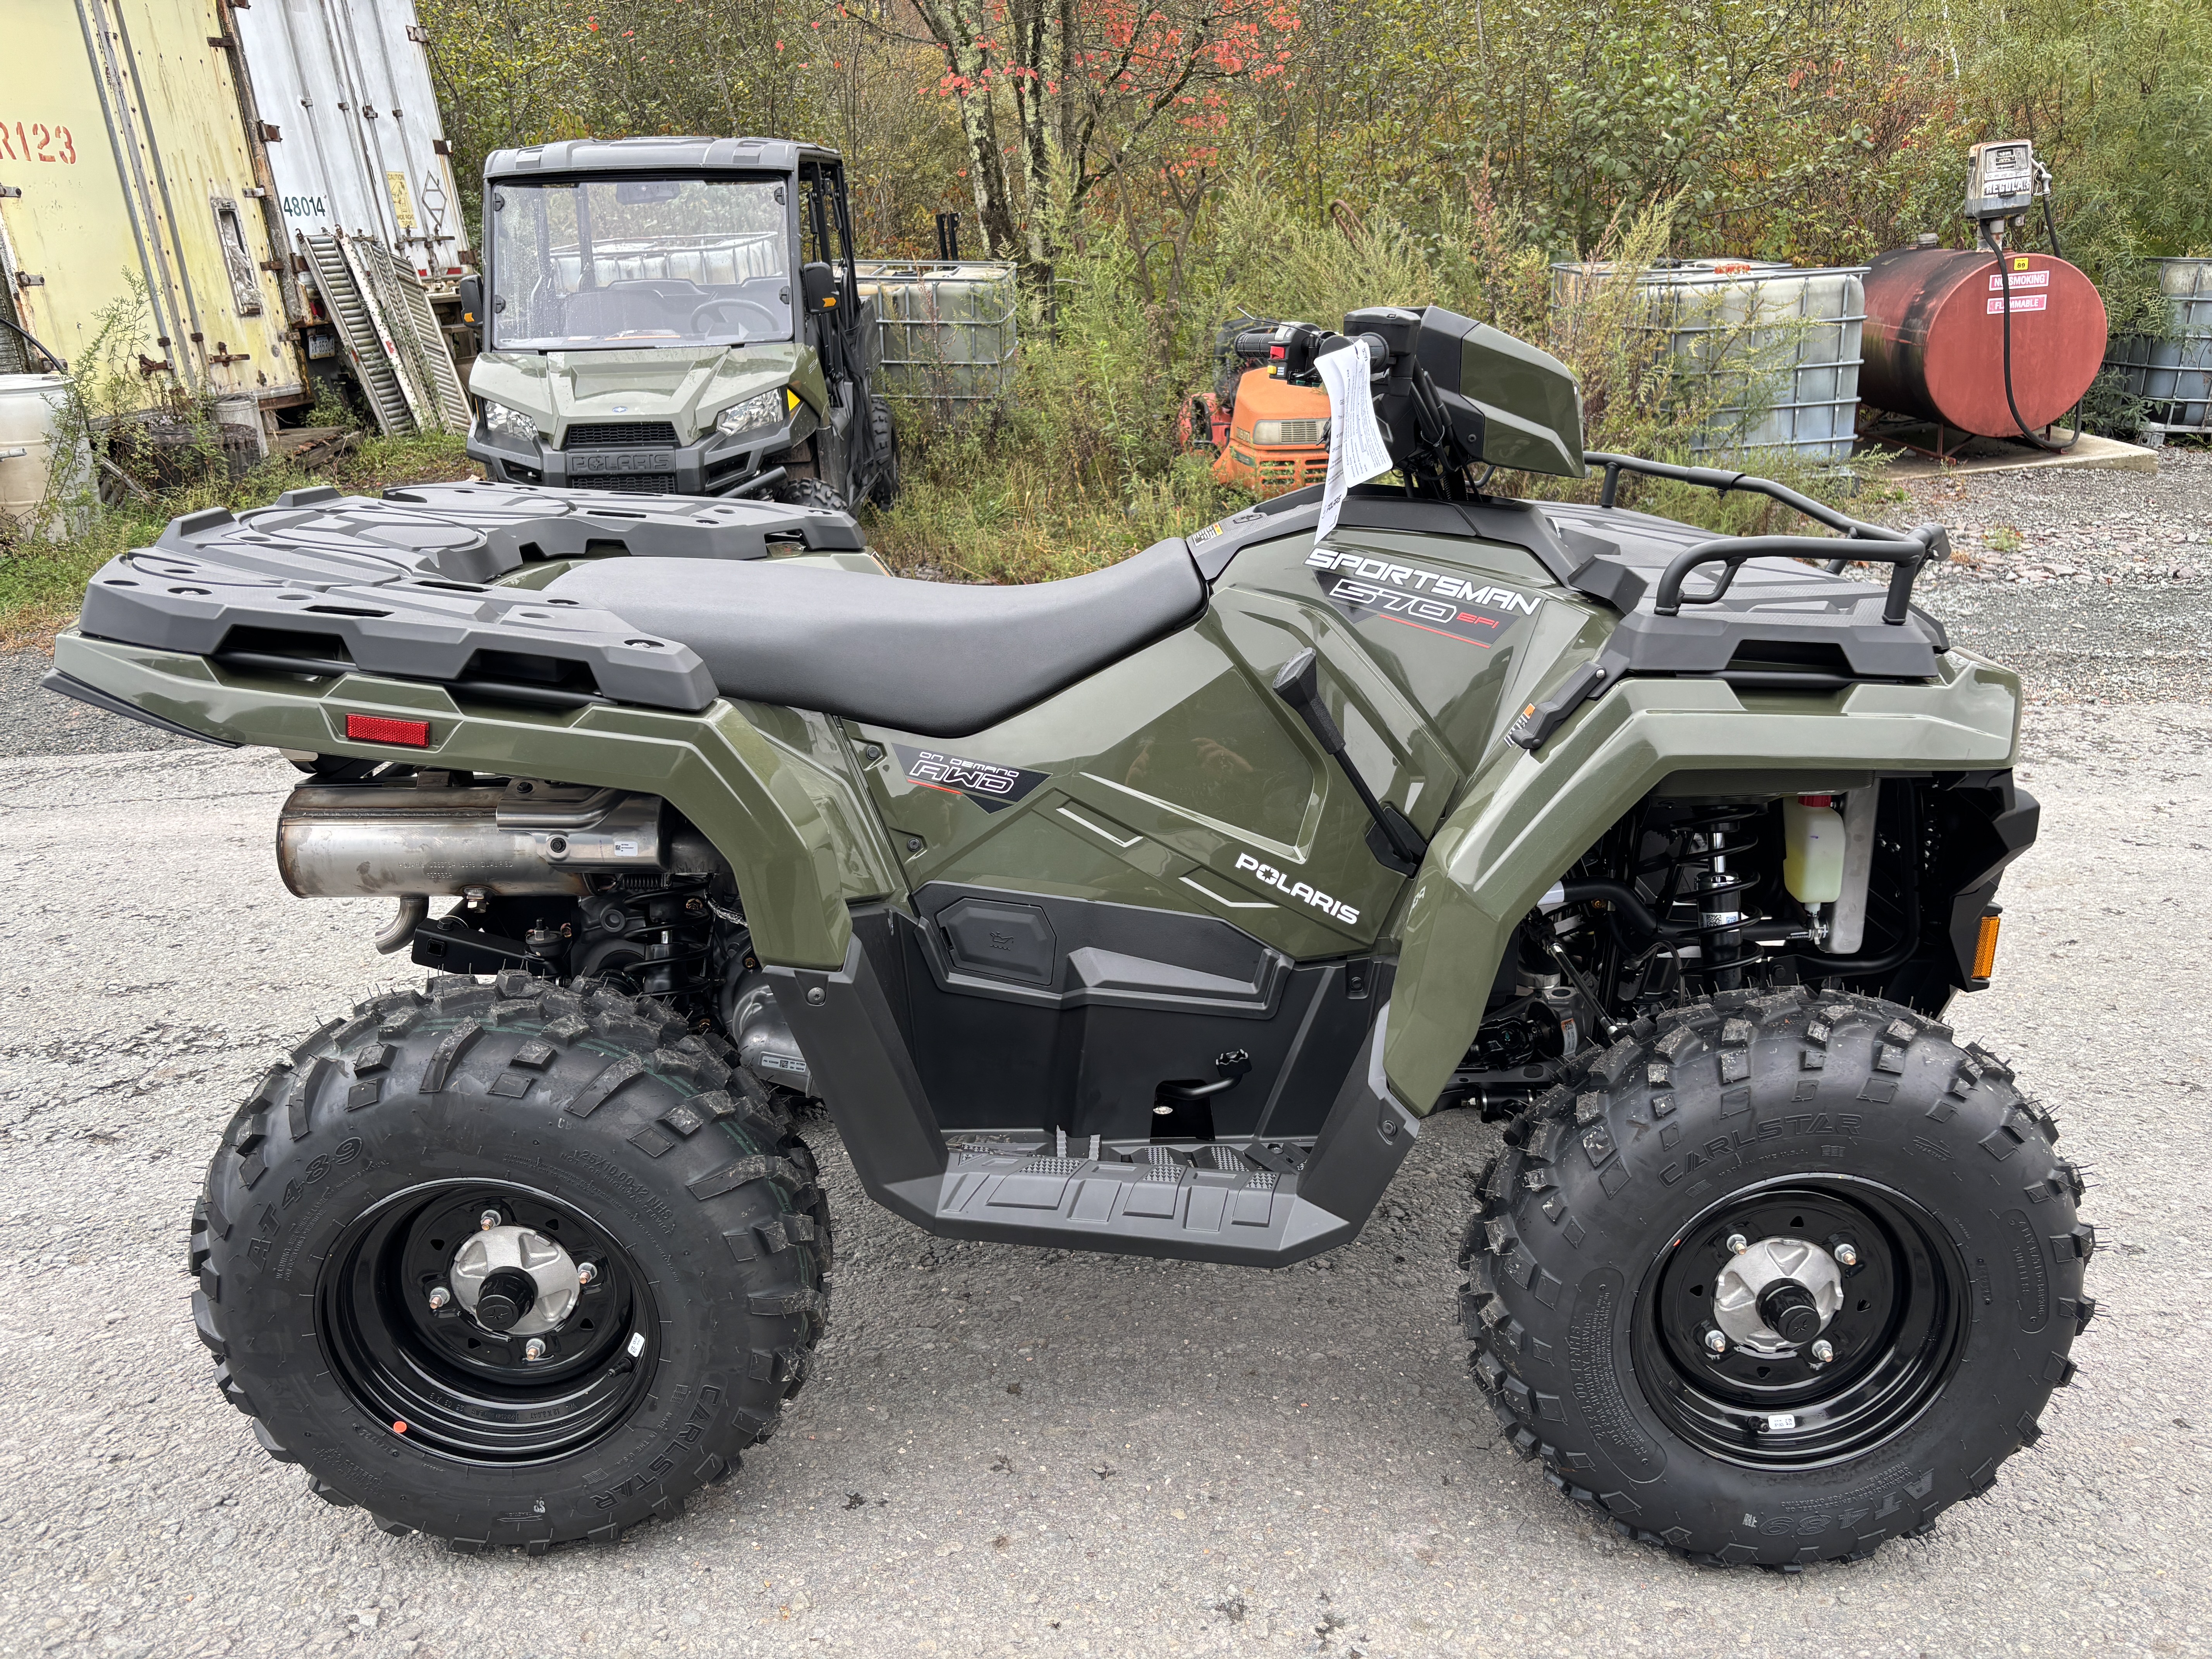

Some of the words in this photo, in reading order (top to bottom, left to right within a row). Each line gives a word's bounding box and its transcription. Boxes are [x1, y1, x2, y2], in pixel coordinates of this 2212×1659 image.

[284, 197, 326, 216] 48014
[2009, 274, 2045, 286] SMOKING
[1995, 299, 2039, 310] FLMMABLE
[572, 454, 669, 471] POLARIS
[1304, 548, 1541, 615] SPORTSMAN
[1329, 578, 1457, 623] 570
[1456, 612, 1499, 629] EFI
[909, 759, 1014, 793] AWD
[919, 751, 943, 762] ON
[950, 758, 1019, 778] DEMAND
[1235, 852, 1360, 924] POLARIS
[1658, 1113, 1862, 1188] CARLSTAR
[581, 1163, 602, 1176] FOR
[602, 1174, 642, 1204] HIGHWAY
[247, 1137, 362, 1273] AT489
[646, 1194, 675, 1220] NHS
[590, 1384, 721, 1510] CARLSTAR
[1759, 1468, 1935, 1536] AT489
